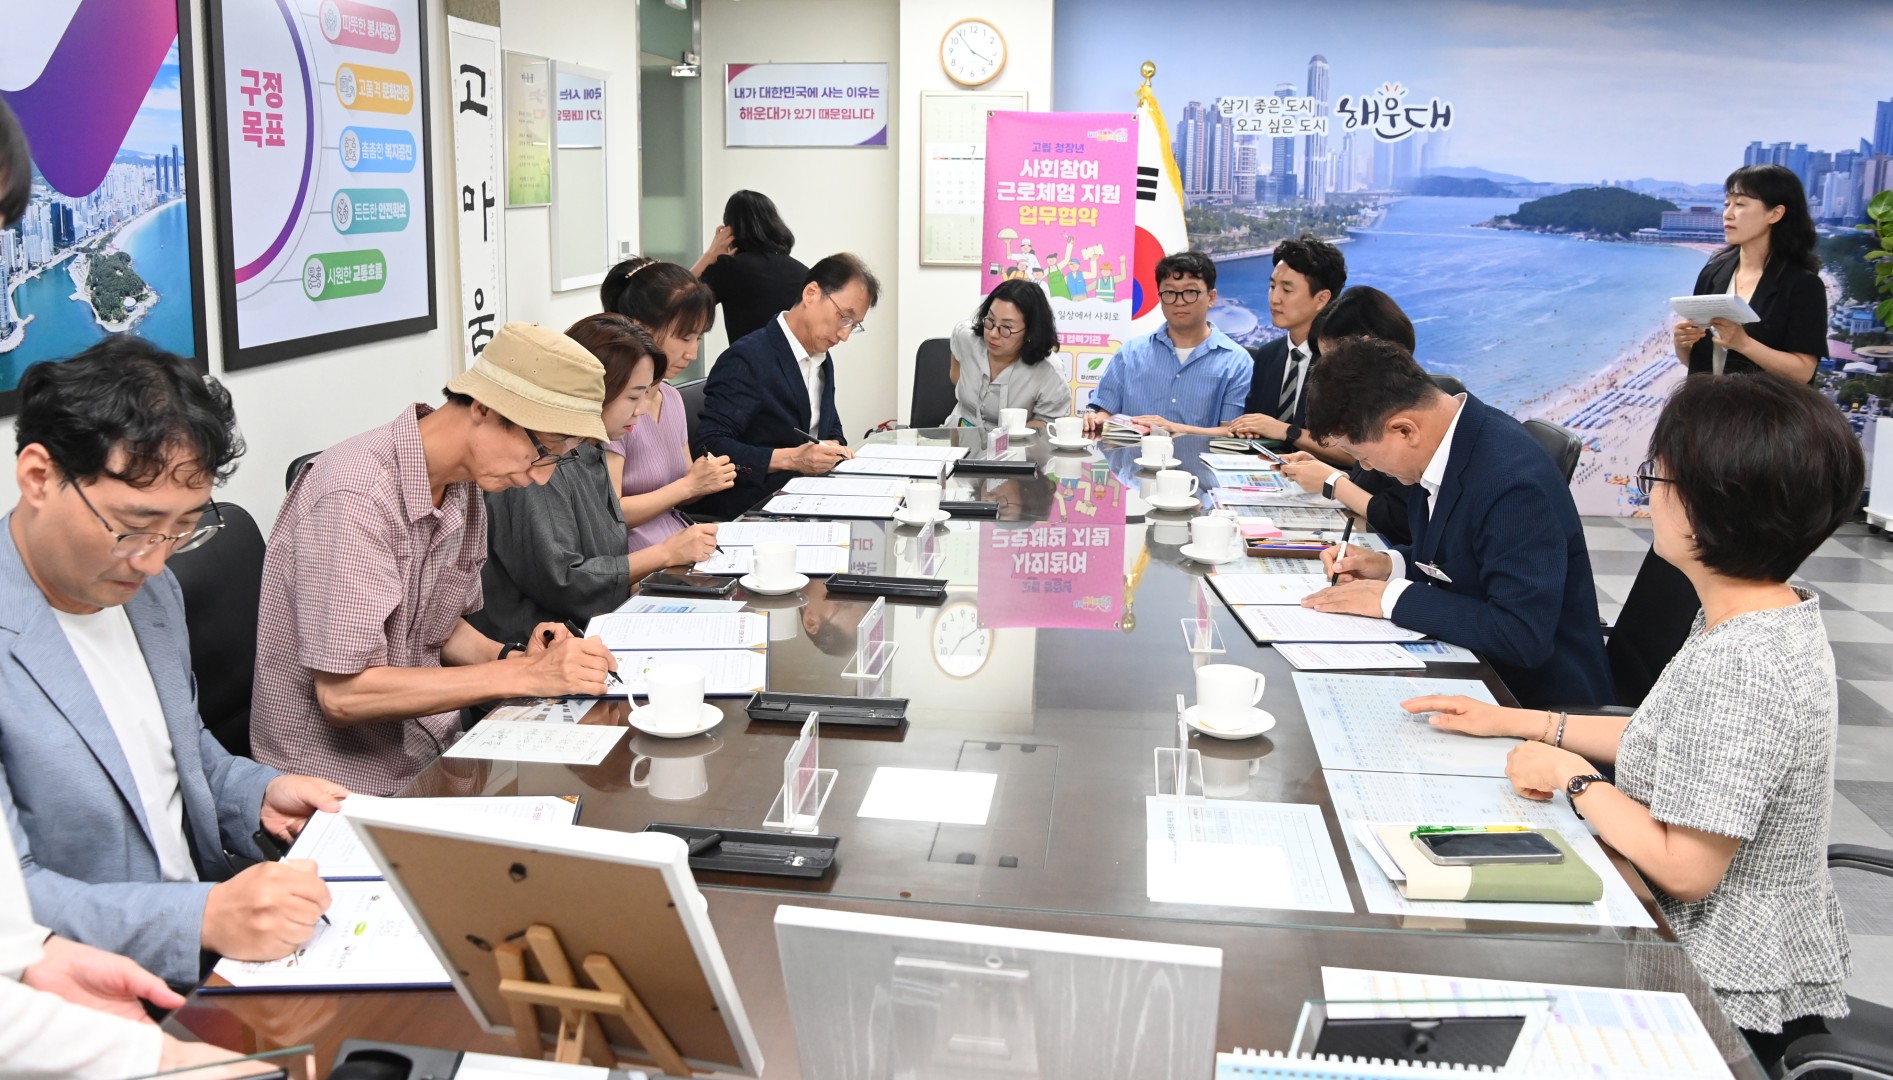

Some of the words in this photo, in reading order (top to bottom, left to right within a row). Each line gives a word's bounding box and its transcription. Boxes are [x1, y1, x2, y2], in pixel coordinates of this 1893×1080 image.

[342, 14, 366, 35] 따뜻한
[367, 19, 397, 41] 봉사행정
[241, 69, 283, 109] 구정
[358, 79, 381, 98] 고품격
[382, 82, 410, 102] 문화관광
[734, 87, 756, 99] 내가
[759, 86, 818, 99] 대한민국에
[821, 87, 843, 99] 사는
[846, 86, 880, 99] 이유는
[739, 106, 791, 121] 해운대가
[793, 108, 816, 120] 있기
[818, 108, 875, 120] 때문입니다
[1221, 98, 1249, 114] 살기
[1253, 98, 1281, 114] 좋은
[1285, 98, 1312, 113] 도시
[1235, 118, 1262, 133] 오고
[1267, 118, 1294, 134] 싶은
[1299, 118, 1326, 133] 도시
[1337, 97, 1451, 139] 해운대
[242, 110, 285, 148] 목표
[361, 141, 384, 160] 촘촘한
[385, 143, 412, 161] 복지증진
[969, 145, 976, 155] 7
[1032, 142, 1051, 153] 고립
[1055, 143, 1084, 154] 청장년
[1019, 158, 1099, 180] 사회참여
[997, 181, 1075, 203] 근로체험
[1080, 183, 1121, 205] 지원
[354, 203, 378, 221] 든든한
[378, 202, 407, 220] 안전확보
[1019, 205, 1099, 228] 업무협약
[327, 266, 352, 286] 시원한
[352, 262, 383, 282] 교통흐름
[1057, 310, 1092, 321] 일상에서
[1094, 311, 1120, 321] 사회로
